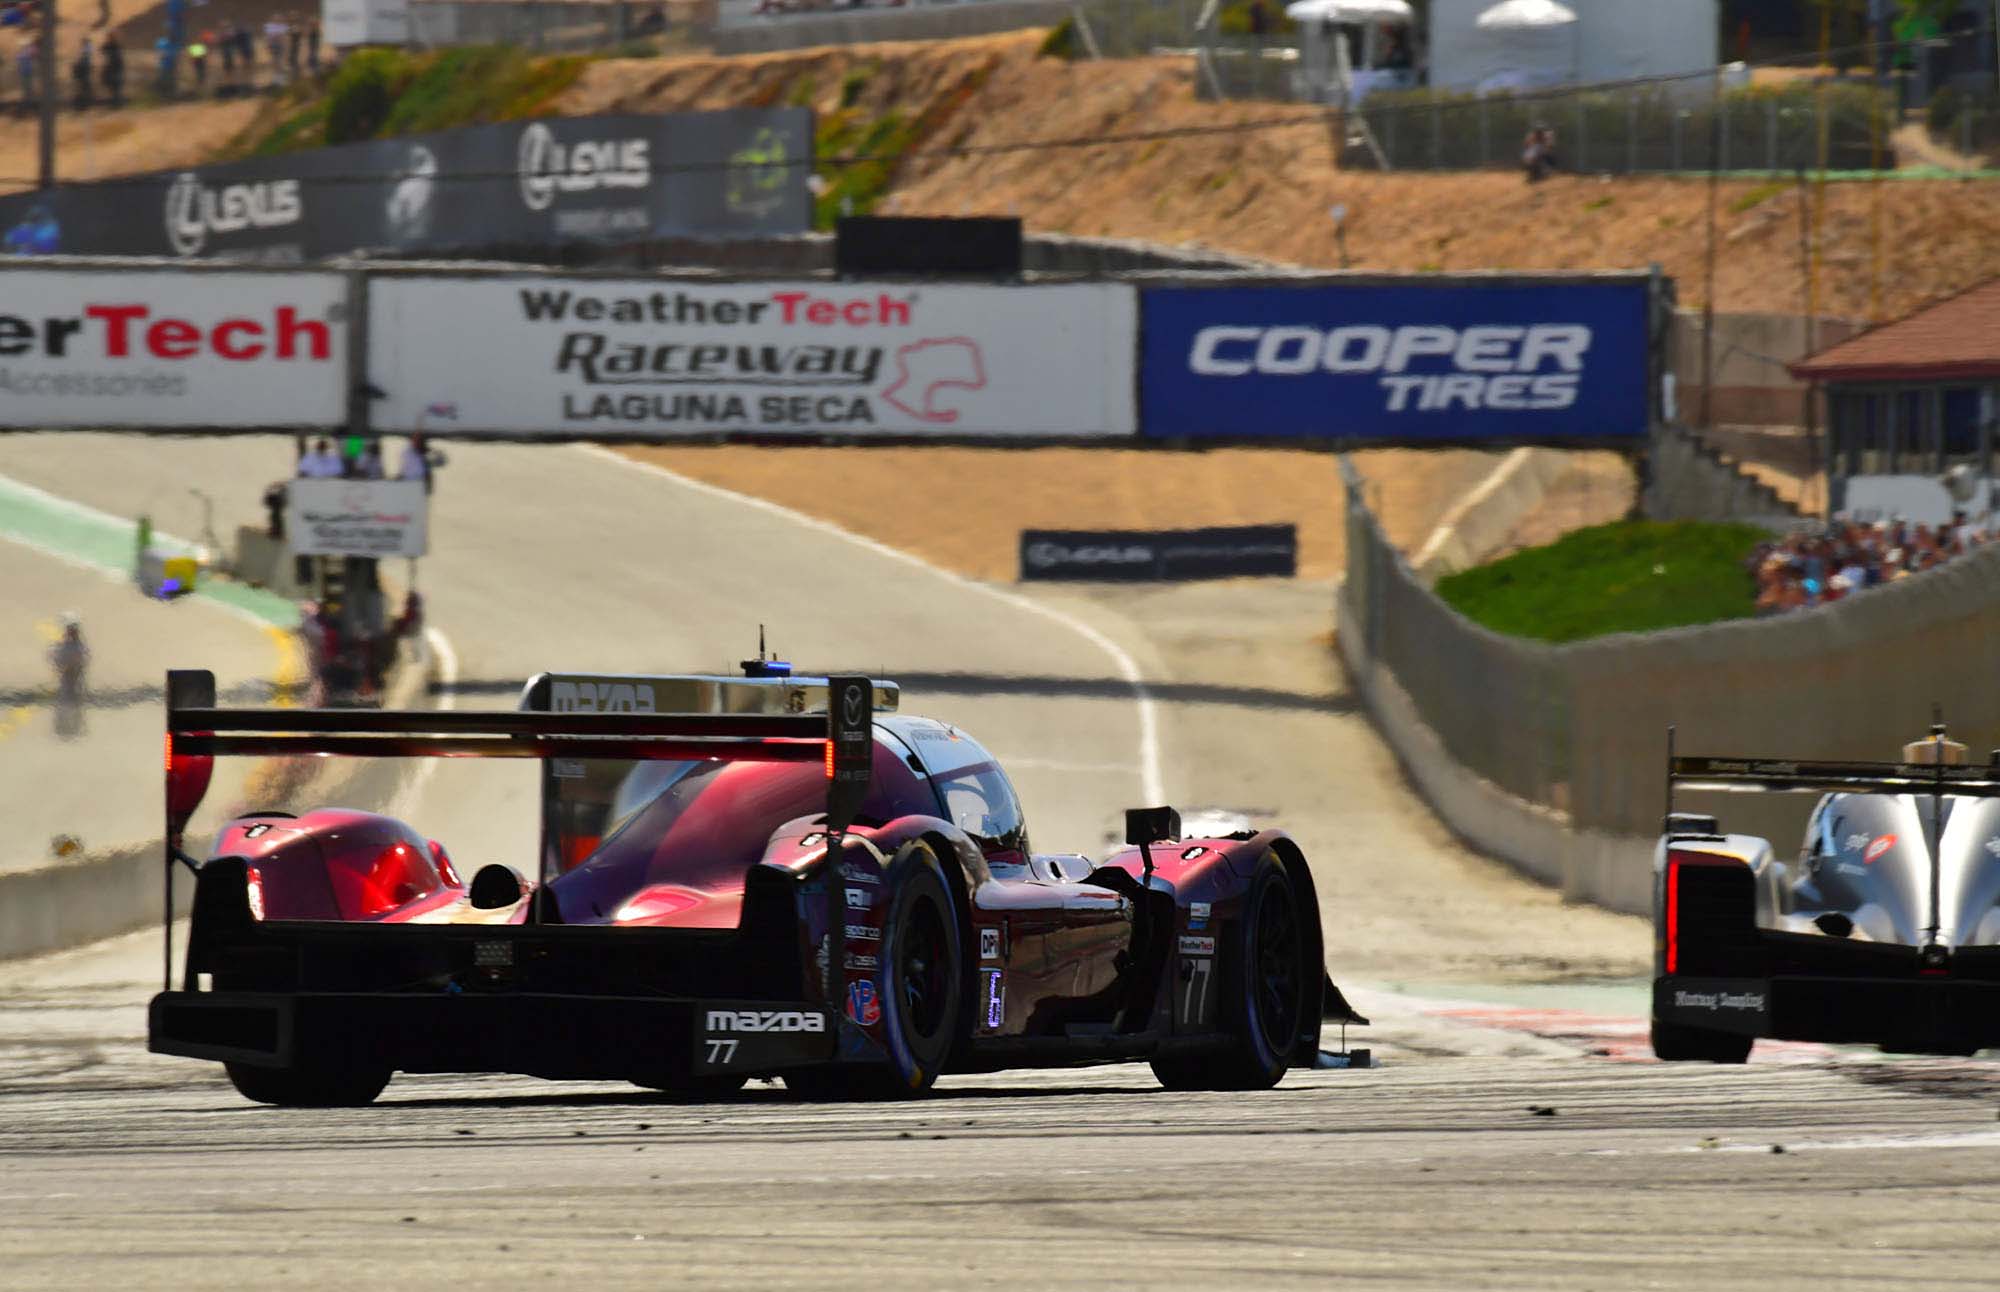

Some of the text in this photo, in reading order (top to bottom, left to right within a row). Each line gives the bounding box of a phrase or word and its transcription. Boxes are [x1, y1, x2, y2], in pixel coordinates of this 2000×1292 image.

[519, 287, 911, 327] WeatherTech
[556, 331, 884, 385] Raceway
[1190, 326, 1591, 375] COOPER
[563, 394, 875, 426] LAGUNA SECA
[1380, 374, 1581, 410] TIRES
[706, 1010, 825, 1032] mazda
[704, 1039, 739, 1064] 77
